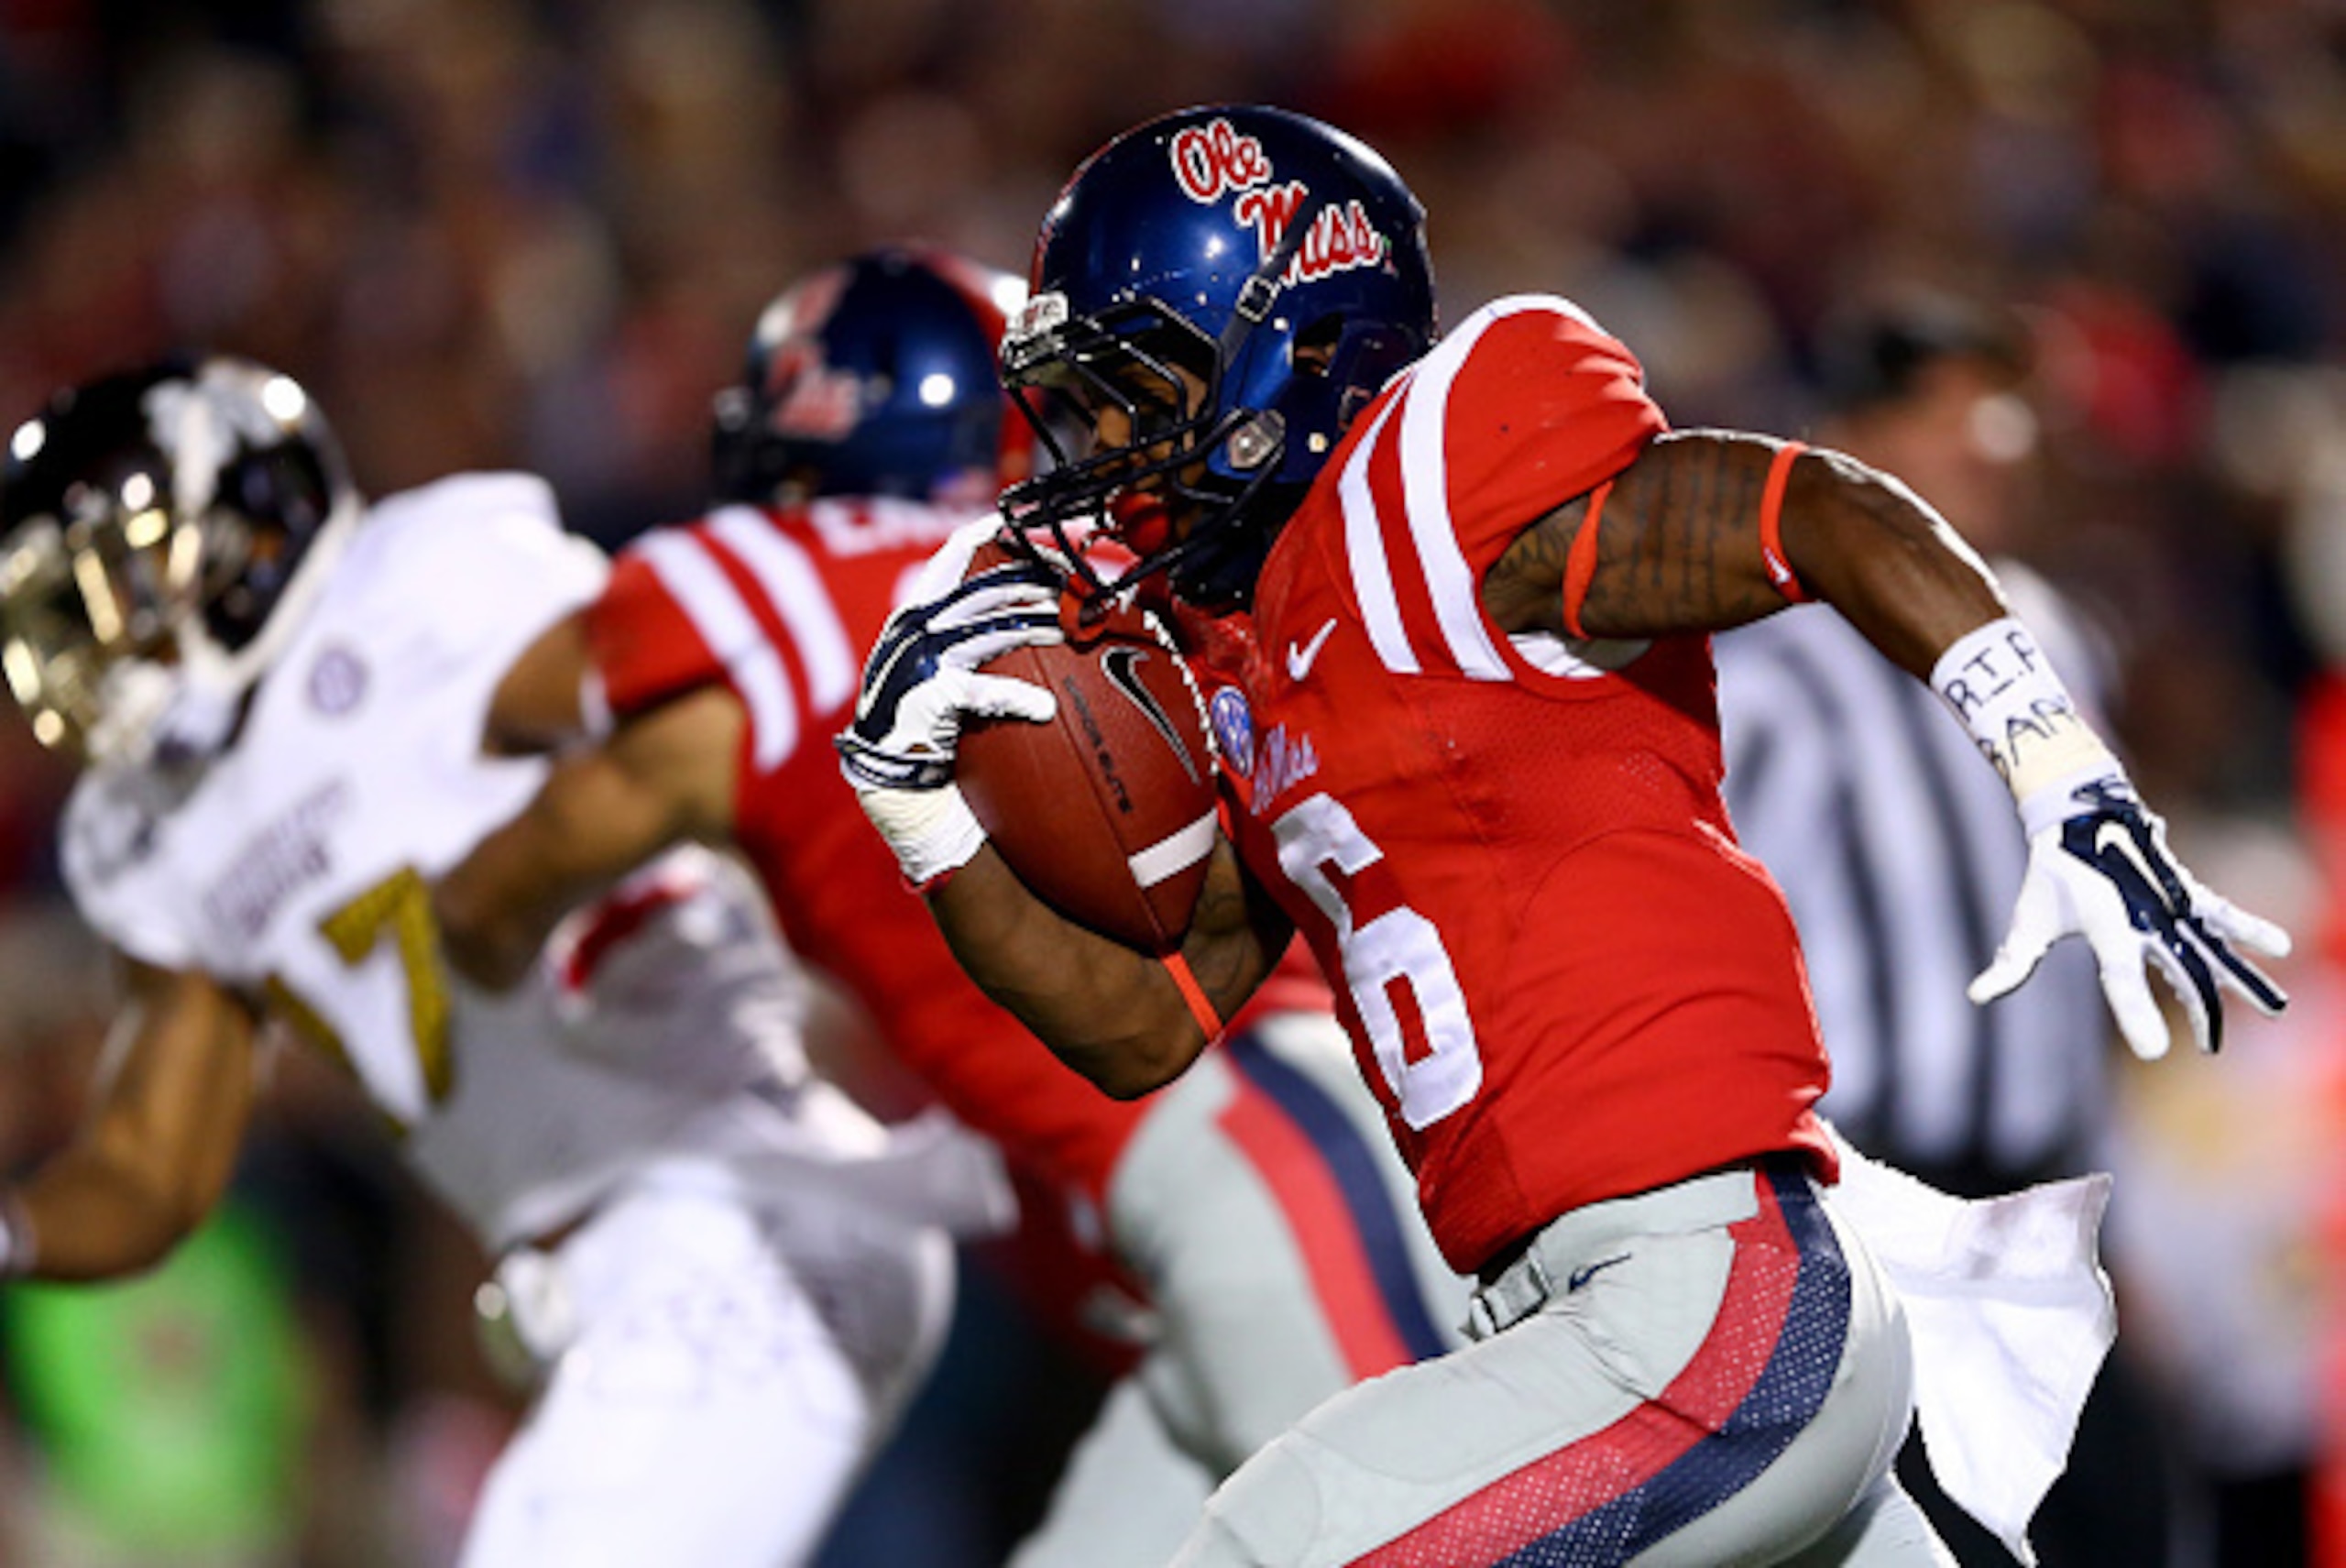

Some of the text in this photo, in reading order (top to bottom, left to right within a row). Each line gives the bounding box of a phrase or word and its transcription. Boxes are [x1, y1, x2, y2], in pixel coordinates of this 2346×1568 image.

[1171, 118, 1273, 204] Ole
[1236, 180, 1383, 291] Miss
[1270, 791, 1483, 1132] 6
